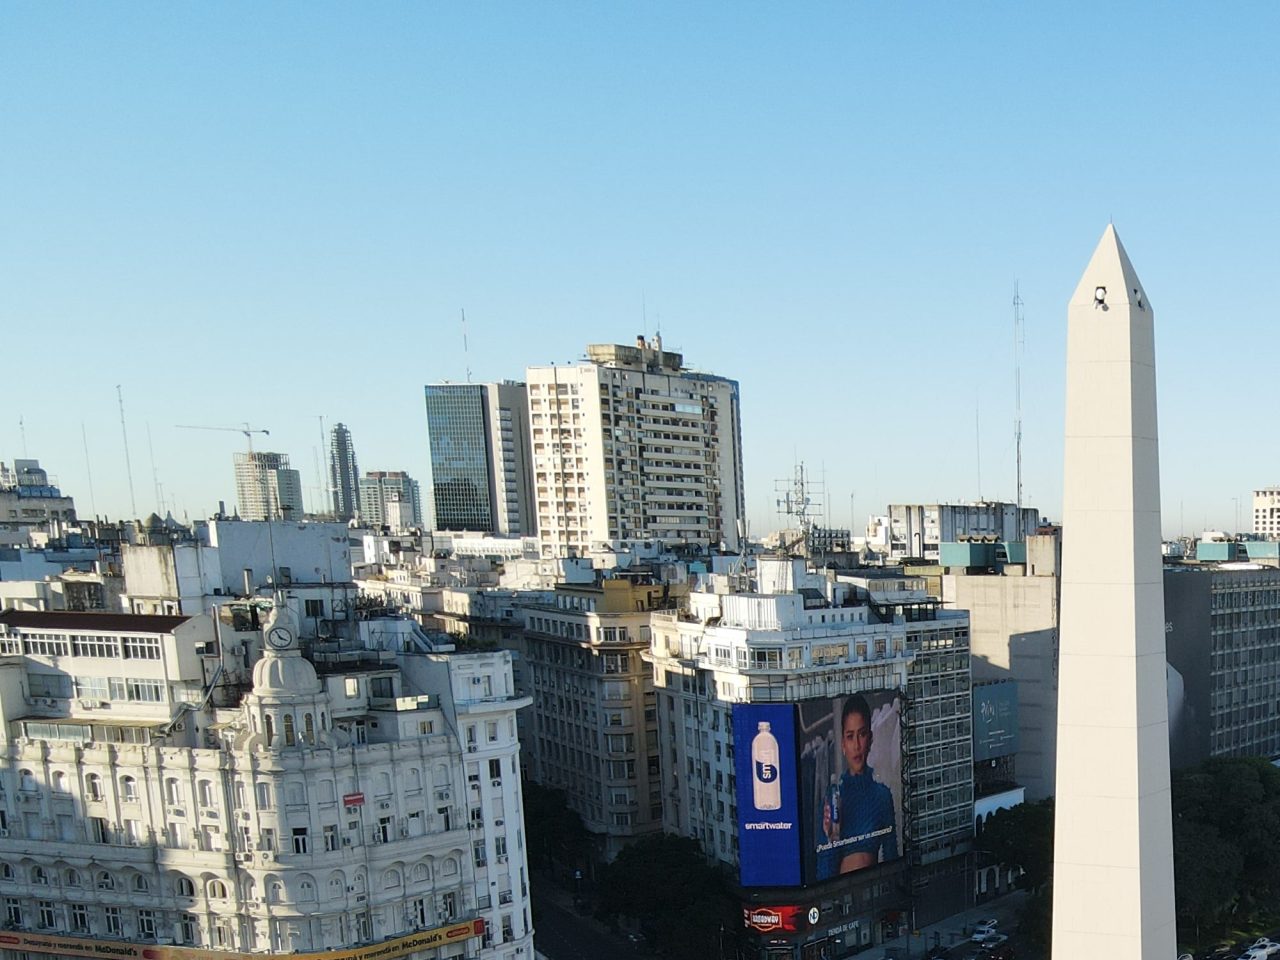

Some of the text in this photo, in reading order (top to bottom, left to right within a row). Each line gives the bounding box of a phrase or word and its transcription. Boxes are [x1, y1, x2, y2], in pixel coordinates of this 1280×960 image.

[745, 822, 792, 830] smartwater
[402, 933, 442, 949] McDonald's
[95, 944, 138, 957] McDonald's
